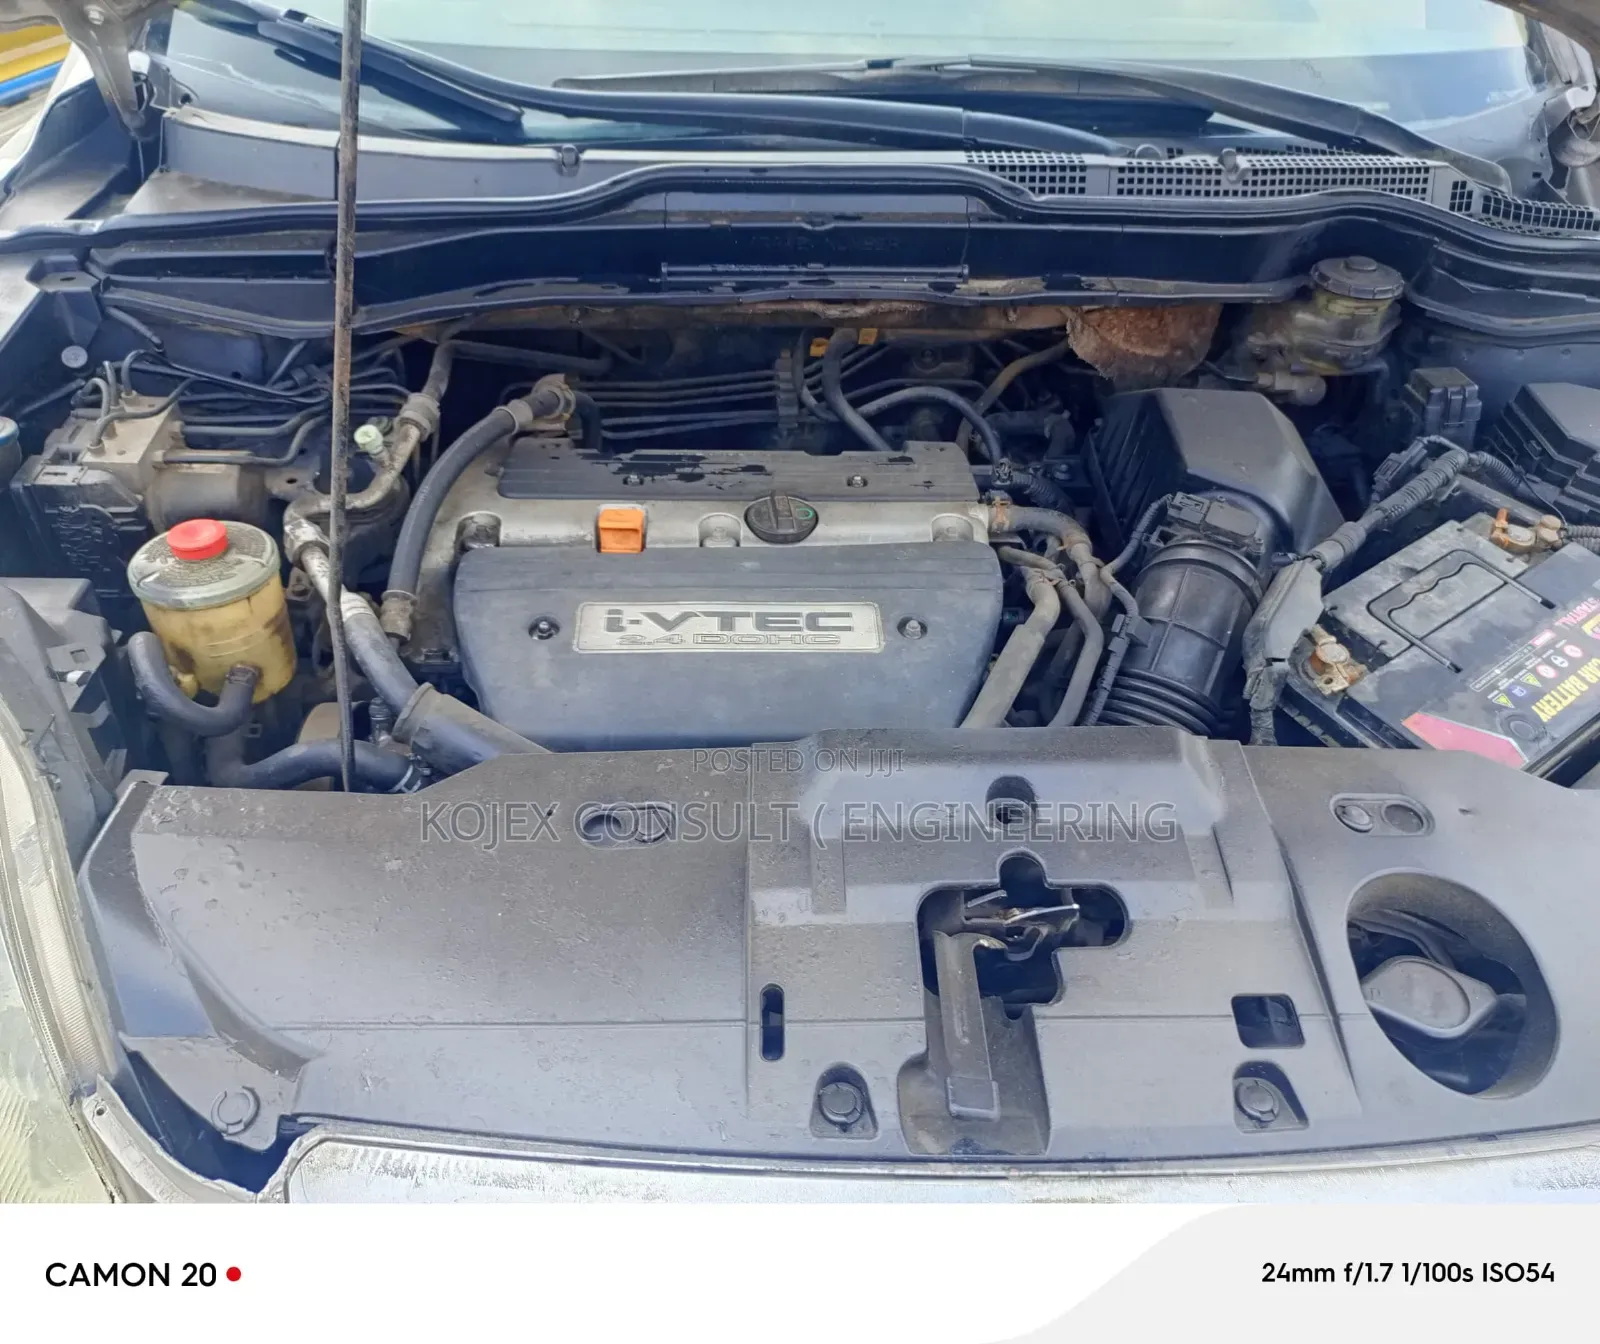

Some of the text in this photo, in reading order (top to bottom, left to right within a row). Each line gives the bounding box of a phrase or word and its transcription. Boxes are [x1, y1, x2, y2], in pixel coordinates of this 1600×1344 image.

[603, 608, 854, 633] i-VTEC
[617, 633, 841, 645] 2.4 DOHC
[1531, 674, 1589, 723] BATTERY
